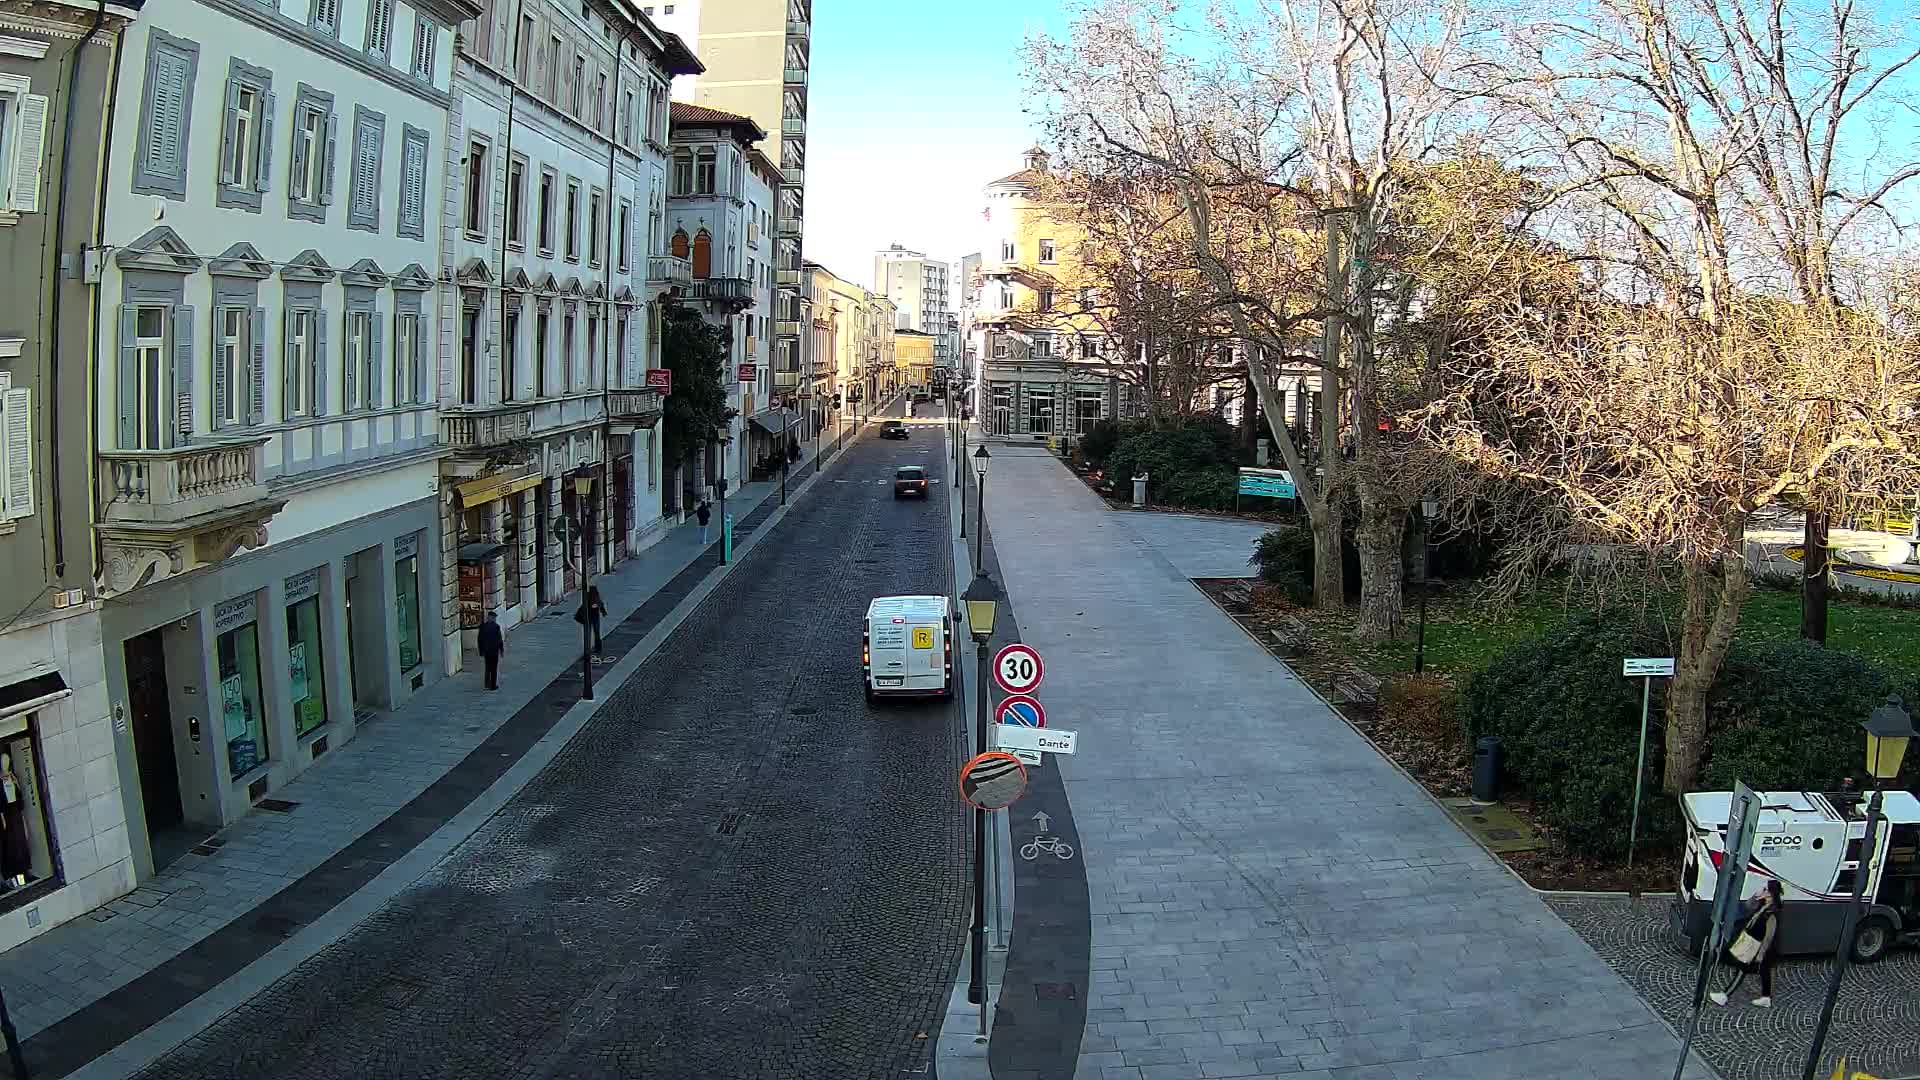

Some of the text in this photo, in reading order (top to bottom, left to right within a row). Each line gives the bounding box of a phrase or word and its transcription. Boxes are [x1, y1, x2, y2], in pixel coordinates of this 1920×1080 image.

[919, 632, 928, 643] R
[1005, 658, 1033, 680] 30
[1039, 737, 1069, 749] Dante
[1762, 836, 1802, 845] 2000
